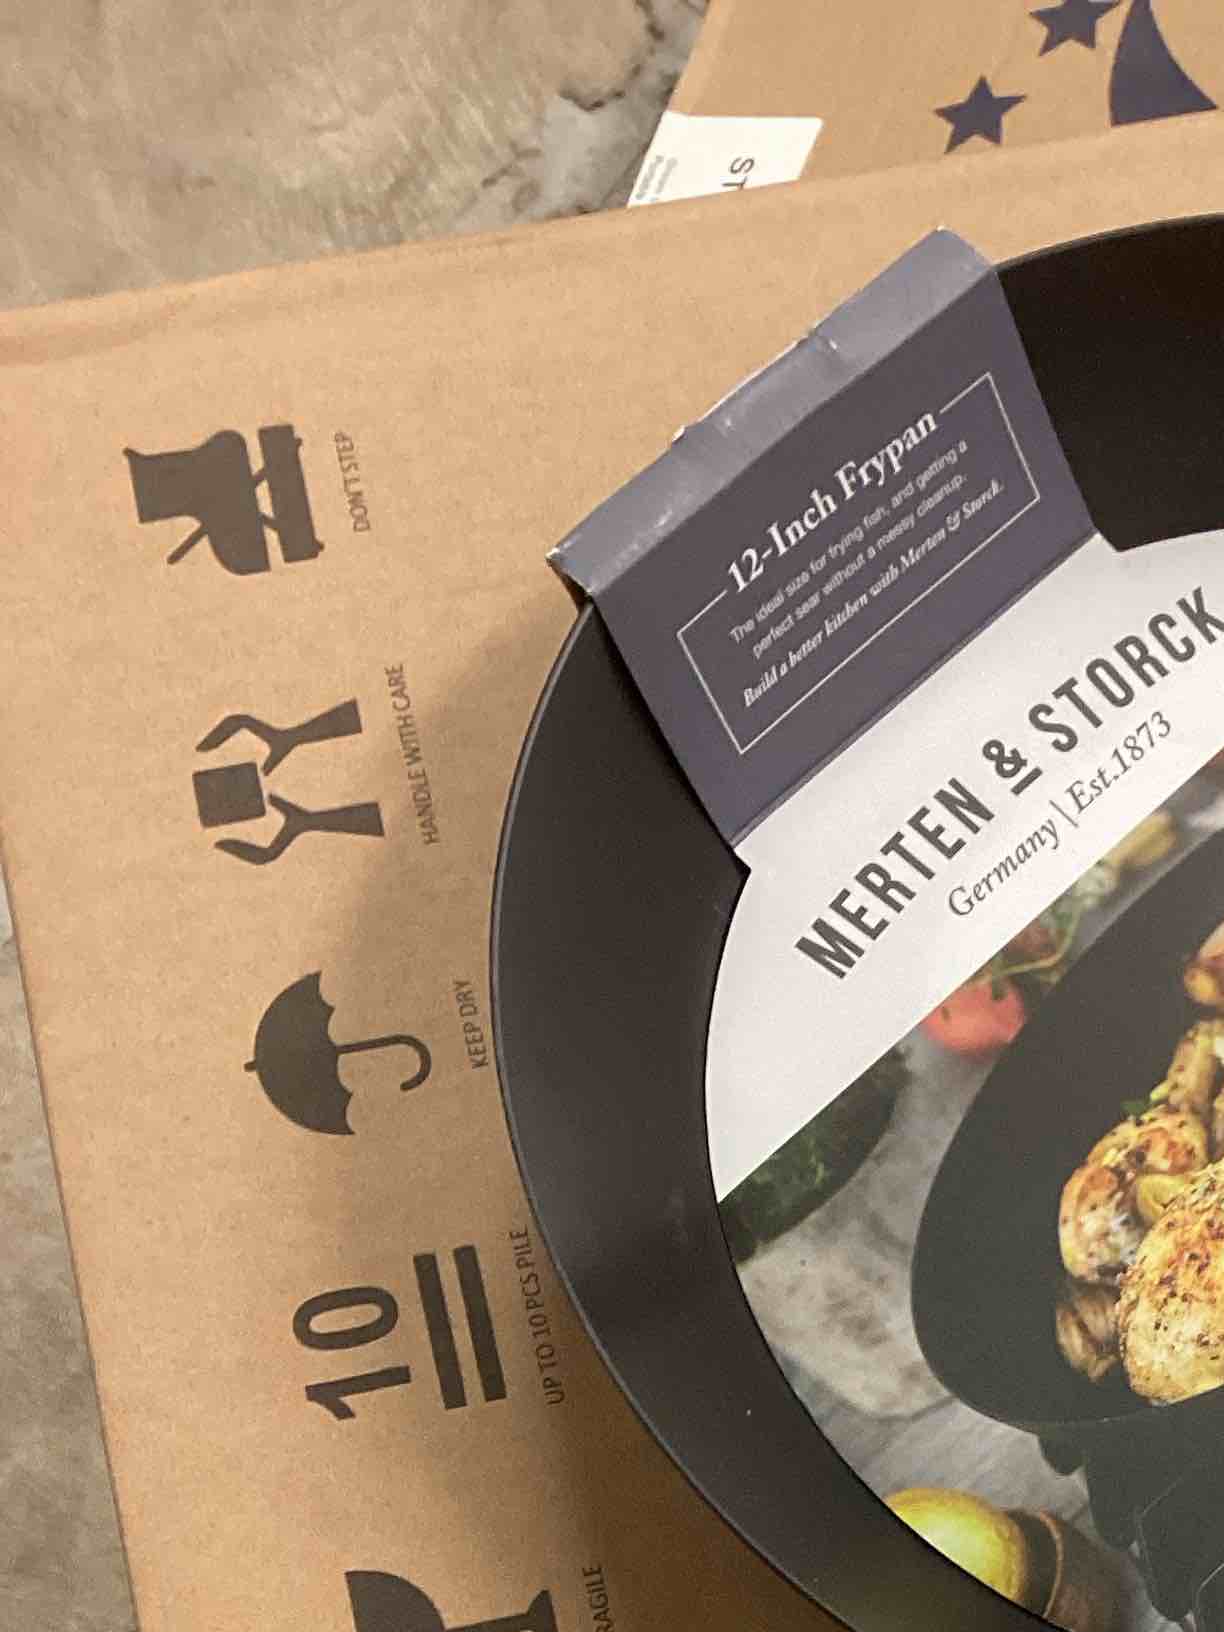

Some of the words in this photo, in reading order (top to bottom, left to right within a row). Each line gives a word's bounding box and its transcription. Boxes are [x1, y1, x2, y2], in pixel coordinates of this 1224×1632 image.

[333, 430, 358, 473] STEP
[342, 477, 370, 533] DON'T
[728, 489, 838, 593] 12-Inch
[834, 413, 938, 501] Frypan
[728, 616, 757, 644] The
[753, 589, 787, 624] ideal
[783, 570, 812, 598] size
[808, 552, 830, 576] for
[826, 525, 866, 561] frying
[861, 504, 892, 531] fish,
[888, 482, 916, 510] and
[913, 448, 958, 491] getting
[955, 438, 970, 455] a
[740, 668, 780, 707] Build
[776, 660, 790, 677] a
[786, 630, 824, 668] better
[821, 592, 870, 638] kitchen
[866, 563, 902, 598] with
[898, 526, 948, 571] Merten
[944, 510, 964, 534] &
[960, 478, 1005, 520] Storck.
[383, 662, 411, 713] CARE
[396, 713, 423, 766] WITH
[406, 768, 440, 845] HANDLE
[948, 818, 1060, 916] Germany
[1065, 711, 1171, 814] Est.1873
[794, 777, 995, 980] MERTEN
[982, 739, 1043, 797] &
[452, 979, 479, 1018] DRY
[462, 1022, 489, 1069] KEEP
[508, 1224, 535, 1270] PILE
[519, 1271, 545, 1312] PCS
[528, 1312, 551, 1339] 10
[292, 1285, 412, 1421] 10
[534, 1342, 558, 1375] TO
[542, 1376, 565, 1405] UP
